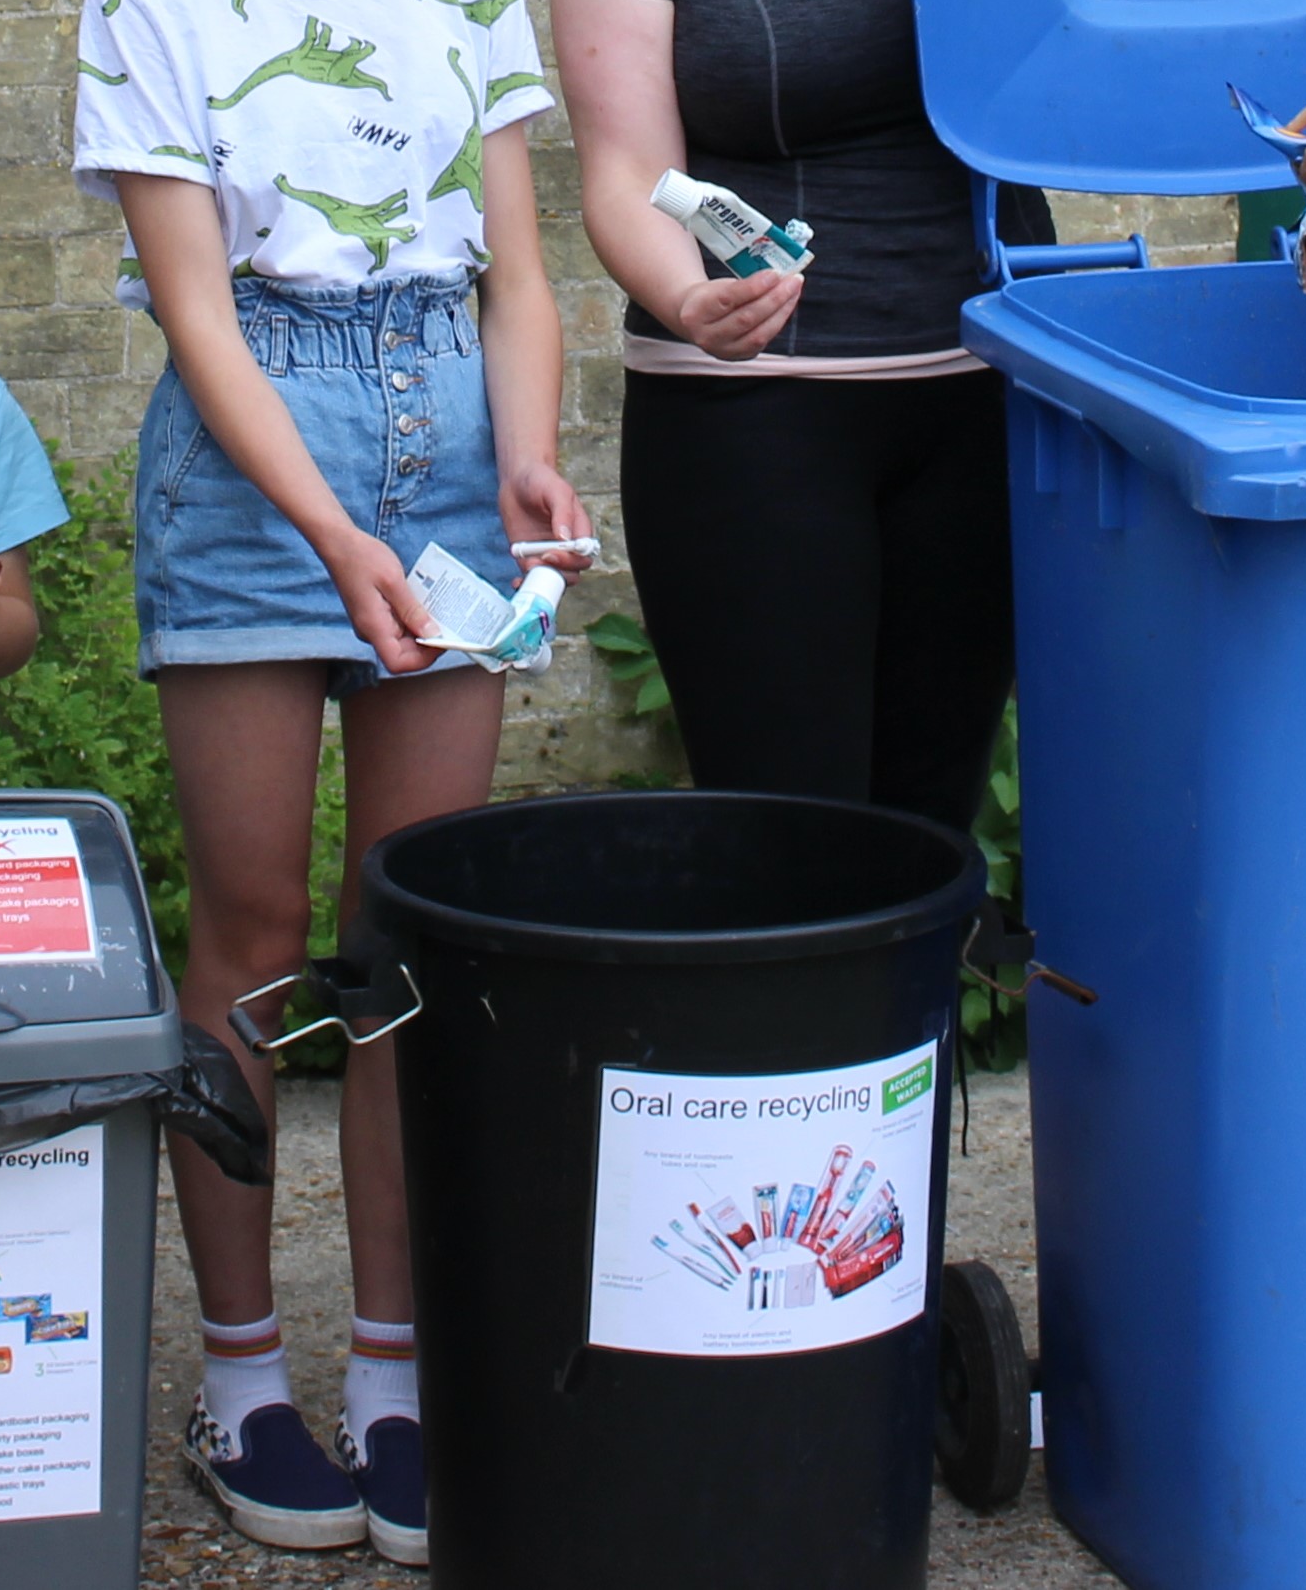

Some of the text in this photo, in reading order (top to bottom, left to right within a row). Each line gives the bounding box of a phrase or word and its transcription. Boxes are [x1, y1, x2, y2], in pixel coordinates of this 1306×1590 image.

[347, 115, 411, 152] RAWR!
[15, 859, 70, 869] packaging
[23, 897, 79, 907] packaging
[3, 913, 31, 923] trays
[888, 1065, 927, 1094] ACCEPTED
[896, 1081, 922, 1103] WASTE
[610, 1086, 871, 1121] Oral care recycling
[34, 1363, 45, 1377] 3
[42, 1412, 90, 1424] packaging
[14, 1430, 61, 1442] packaging
[16, 1447, 45, 1457] boxes
[17, 1464, 40, 1473] cake
[43, 1460, 90, 1472] packaging
[23, 1479, 45, 1490] trays
